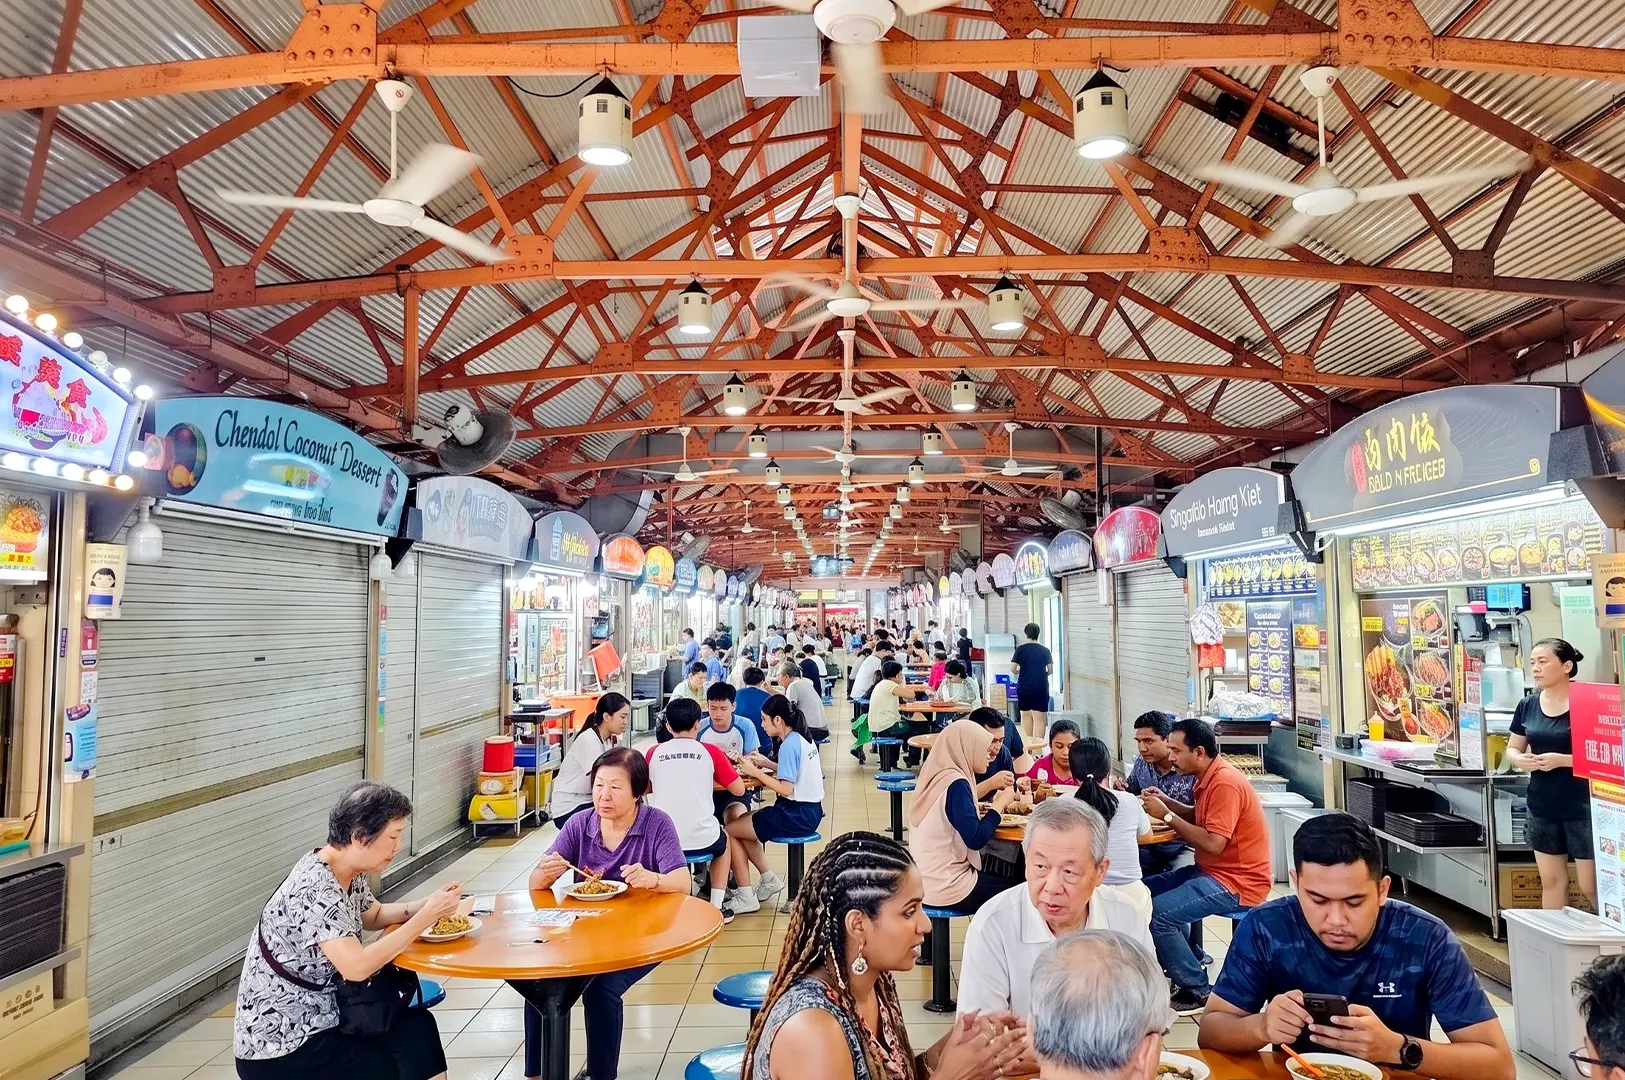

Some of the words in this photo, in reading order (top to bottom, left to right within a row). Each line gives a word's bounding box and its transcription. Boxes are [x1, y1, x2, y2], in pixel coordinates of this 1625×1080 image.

[215, 409, 283, 452] Chendol
[283, 420, 338, 466] Coconut
[340, 441, 382, 488] Dessert
